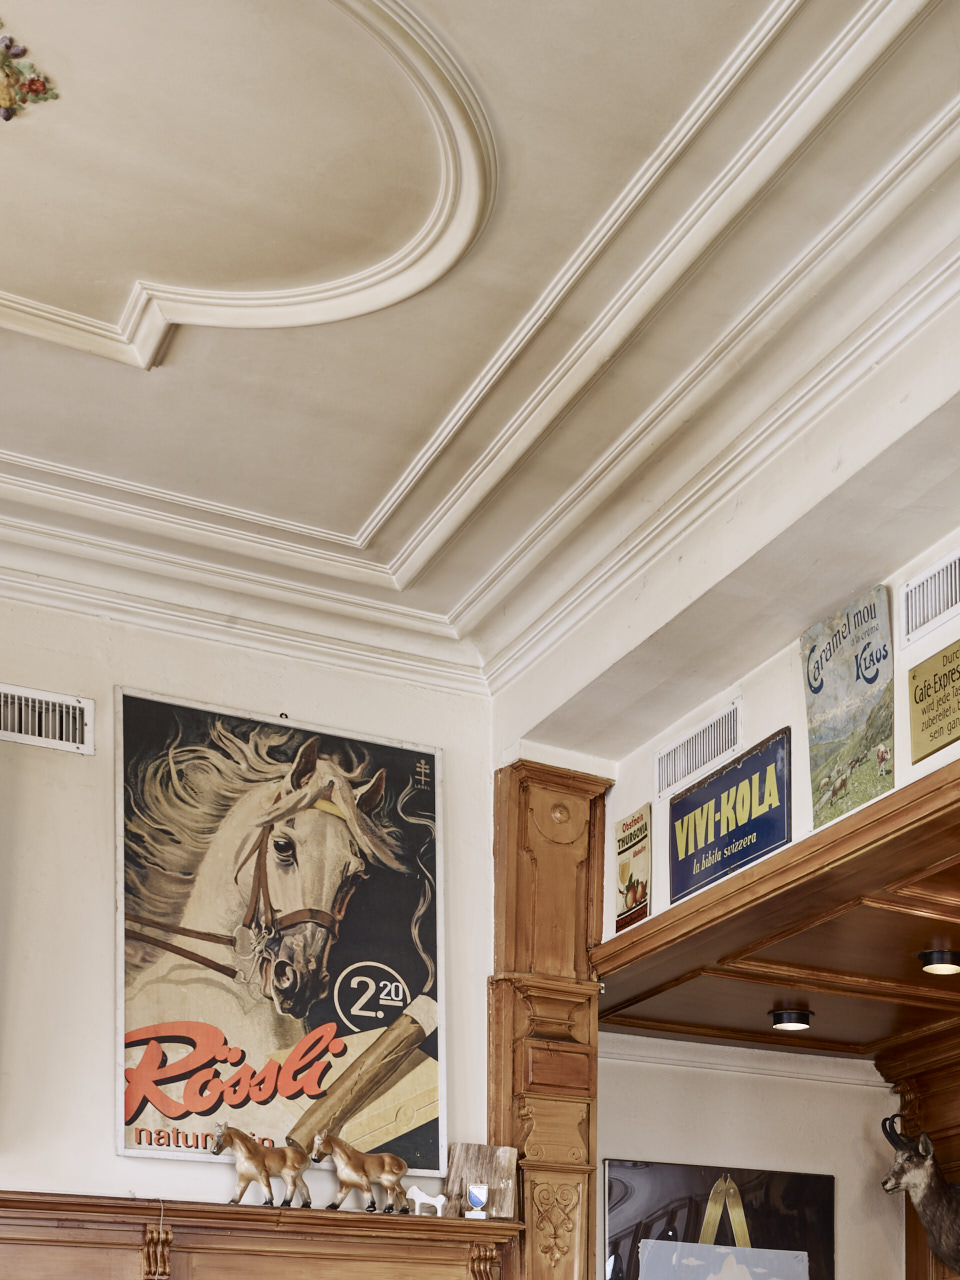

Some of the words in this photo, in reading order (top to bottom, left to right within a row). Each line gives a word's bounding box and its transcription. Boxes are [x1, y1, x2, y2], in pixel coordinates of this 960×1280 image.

[807, 612, 851, 694] Caramel
[853, 603, 876, 630] mou
[855, 641, 888, 684] KLAUS
[921, 699, 935, 715] wird
[935, 691, 951, 712] jede
[921, 705, 952, 732] zubereitet
[929, 725, 944, 742] sein
[674, 762, 780, 861] VIVI-KOLA
[617, 821, 648, 850] THURGOVIA
[693, 859, 699, 875] la
[701, 847, 721, 871] bibita
[723, 832, 757, 858] svizzera
[124, 1020, 348, 1126] Rössli
